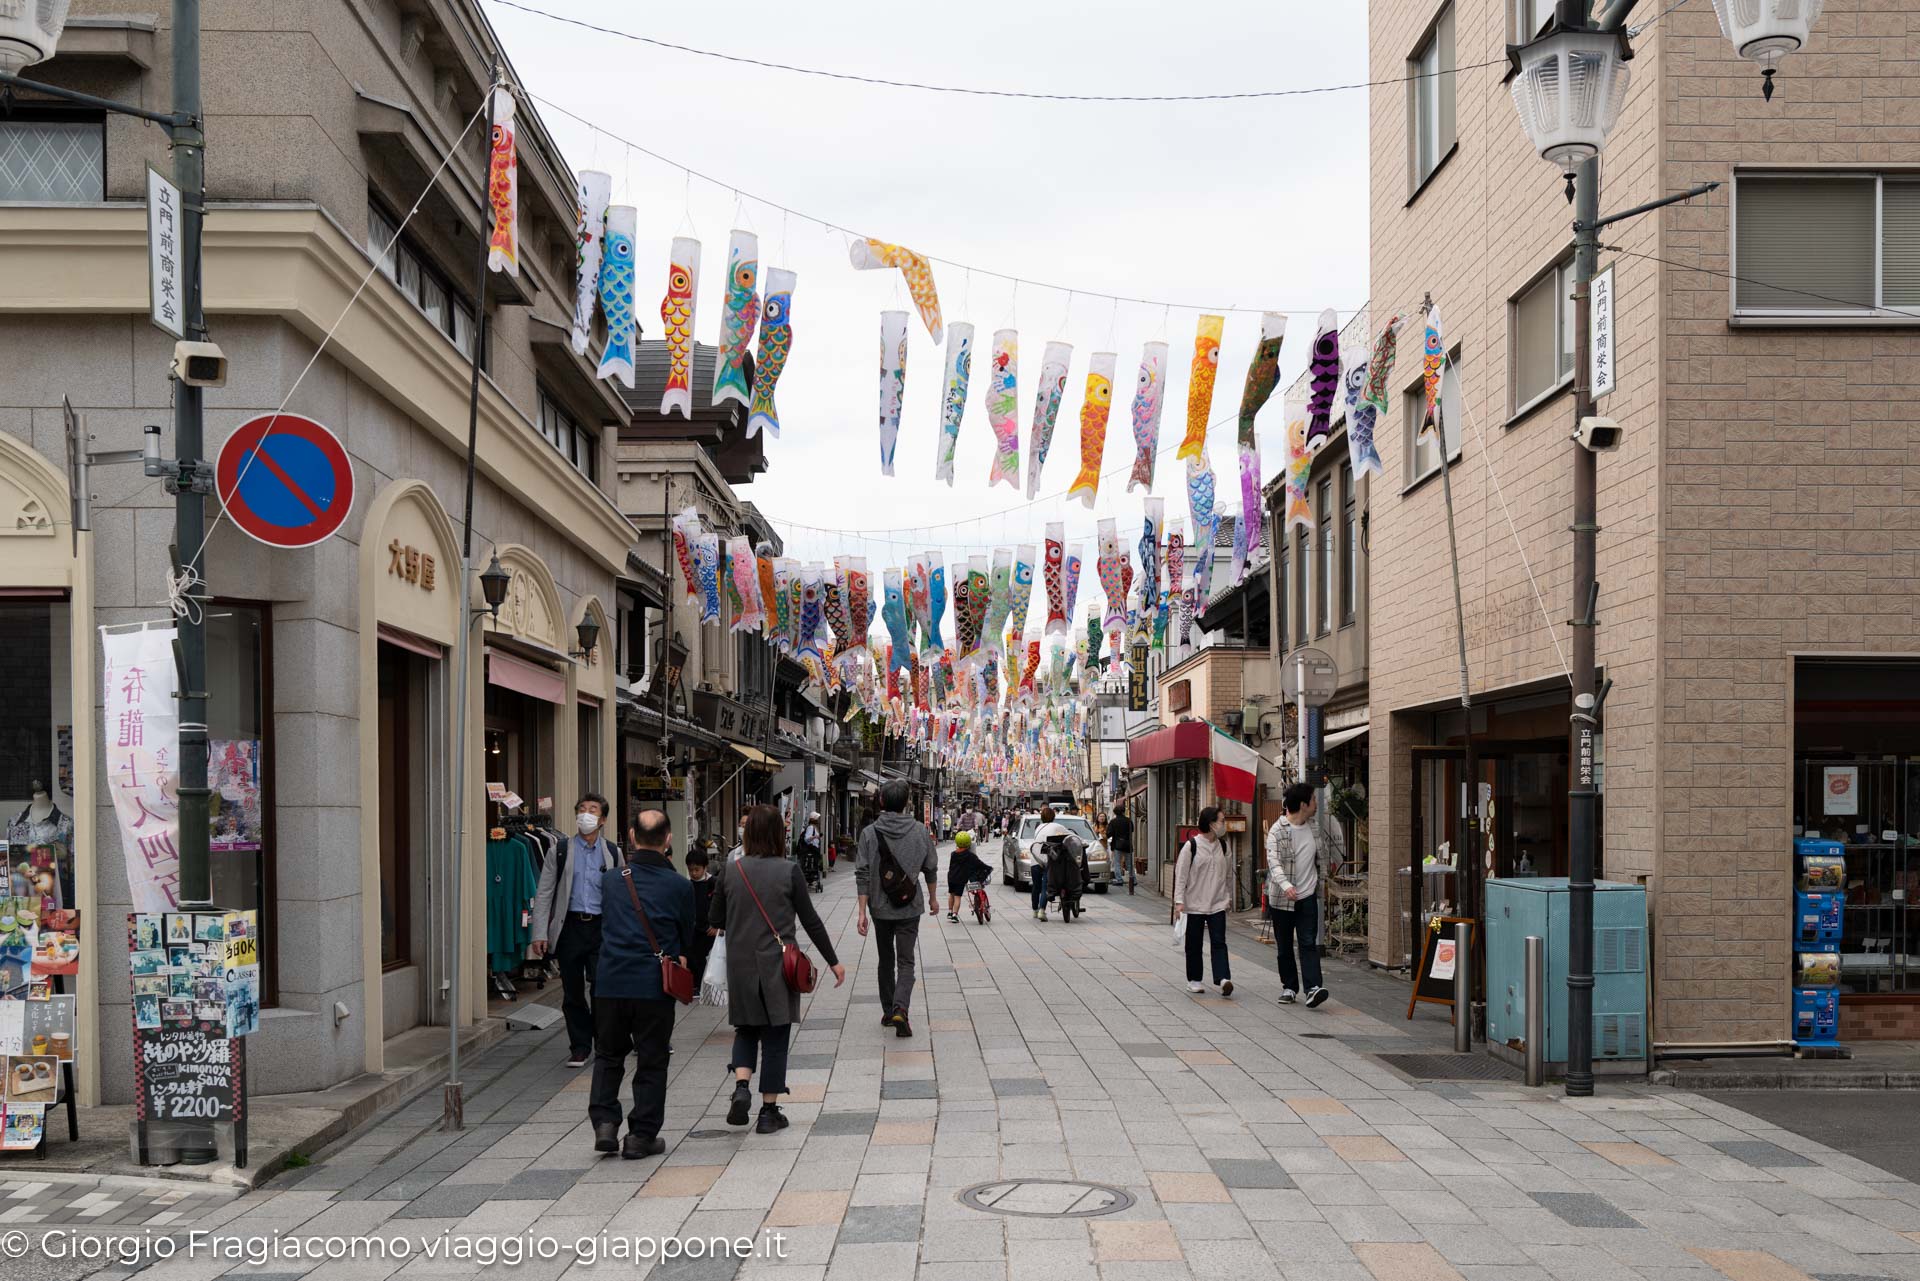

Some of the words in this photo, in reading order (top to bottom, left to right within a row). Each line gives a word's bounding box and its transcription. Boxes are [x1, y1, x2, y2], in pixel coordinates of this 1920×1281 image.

[159, 187, 176, 323] 立門前商栄会
[1596, 279, 1607, 388] 立門前商栄会
[388, 538, 436, 592] 大野屋
[1580, 728, 1592, 785] 立門前商栄会
[143, 1039, 232, 1064] きものや沙羅
[178, 1063, 232, 1077] kimonoya
